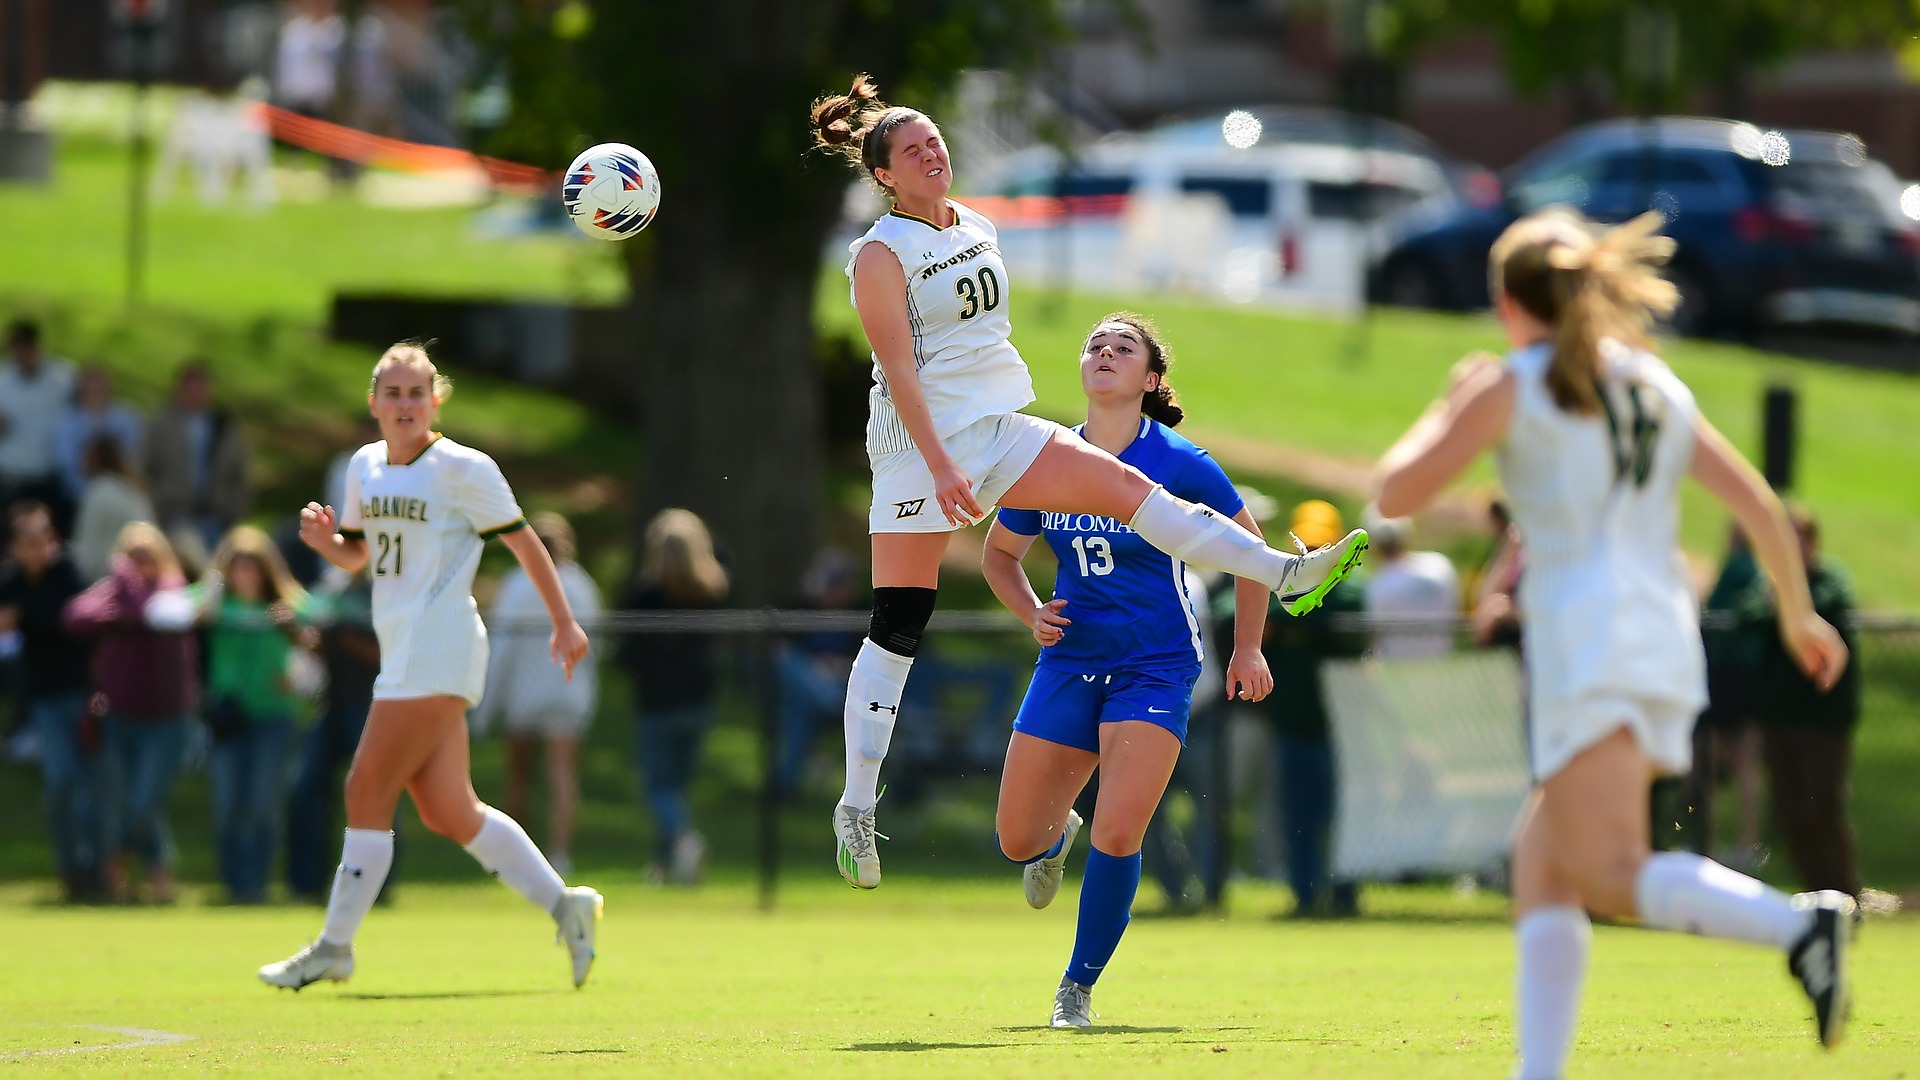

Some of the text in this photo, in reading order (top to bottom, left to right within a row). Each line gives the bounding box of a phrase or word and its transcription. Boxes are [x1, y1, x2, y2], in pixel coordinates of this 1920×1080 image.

[954, 265, 1001, 321] 30
[1040, 511, 1136, 533] DIPLOMA
[376, 531, 403, 576] 21
[1071, 535, 1115, 577] 13
